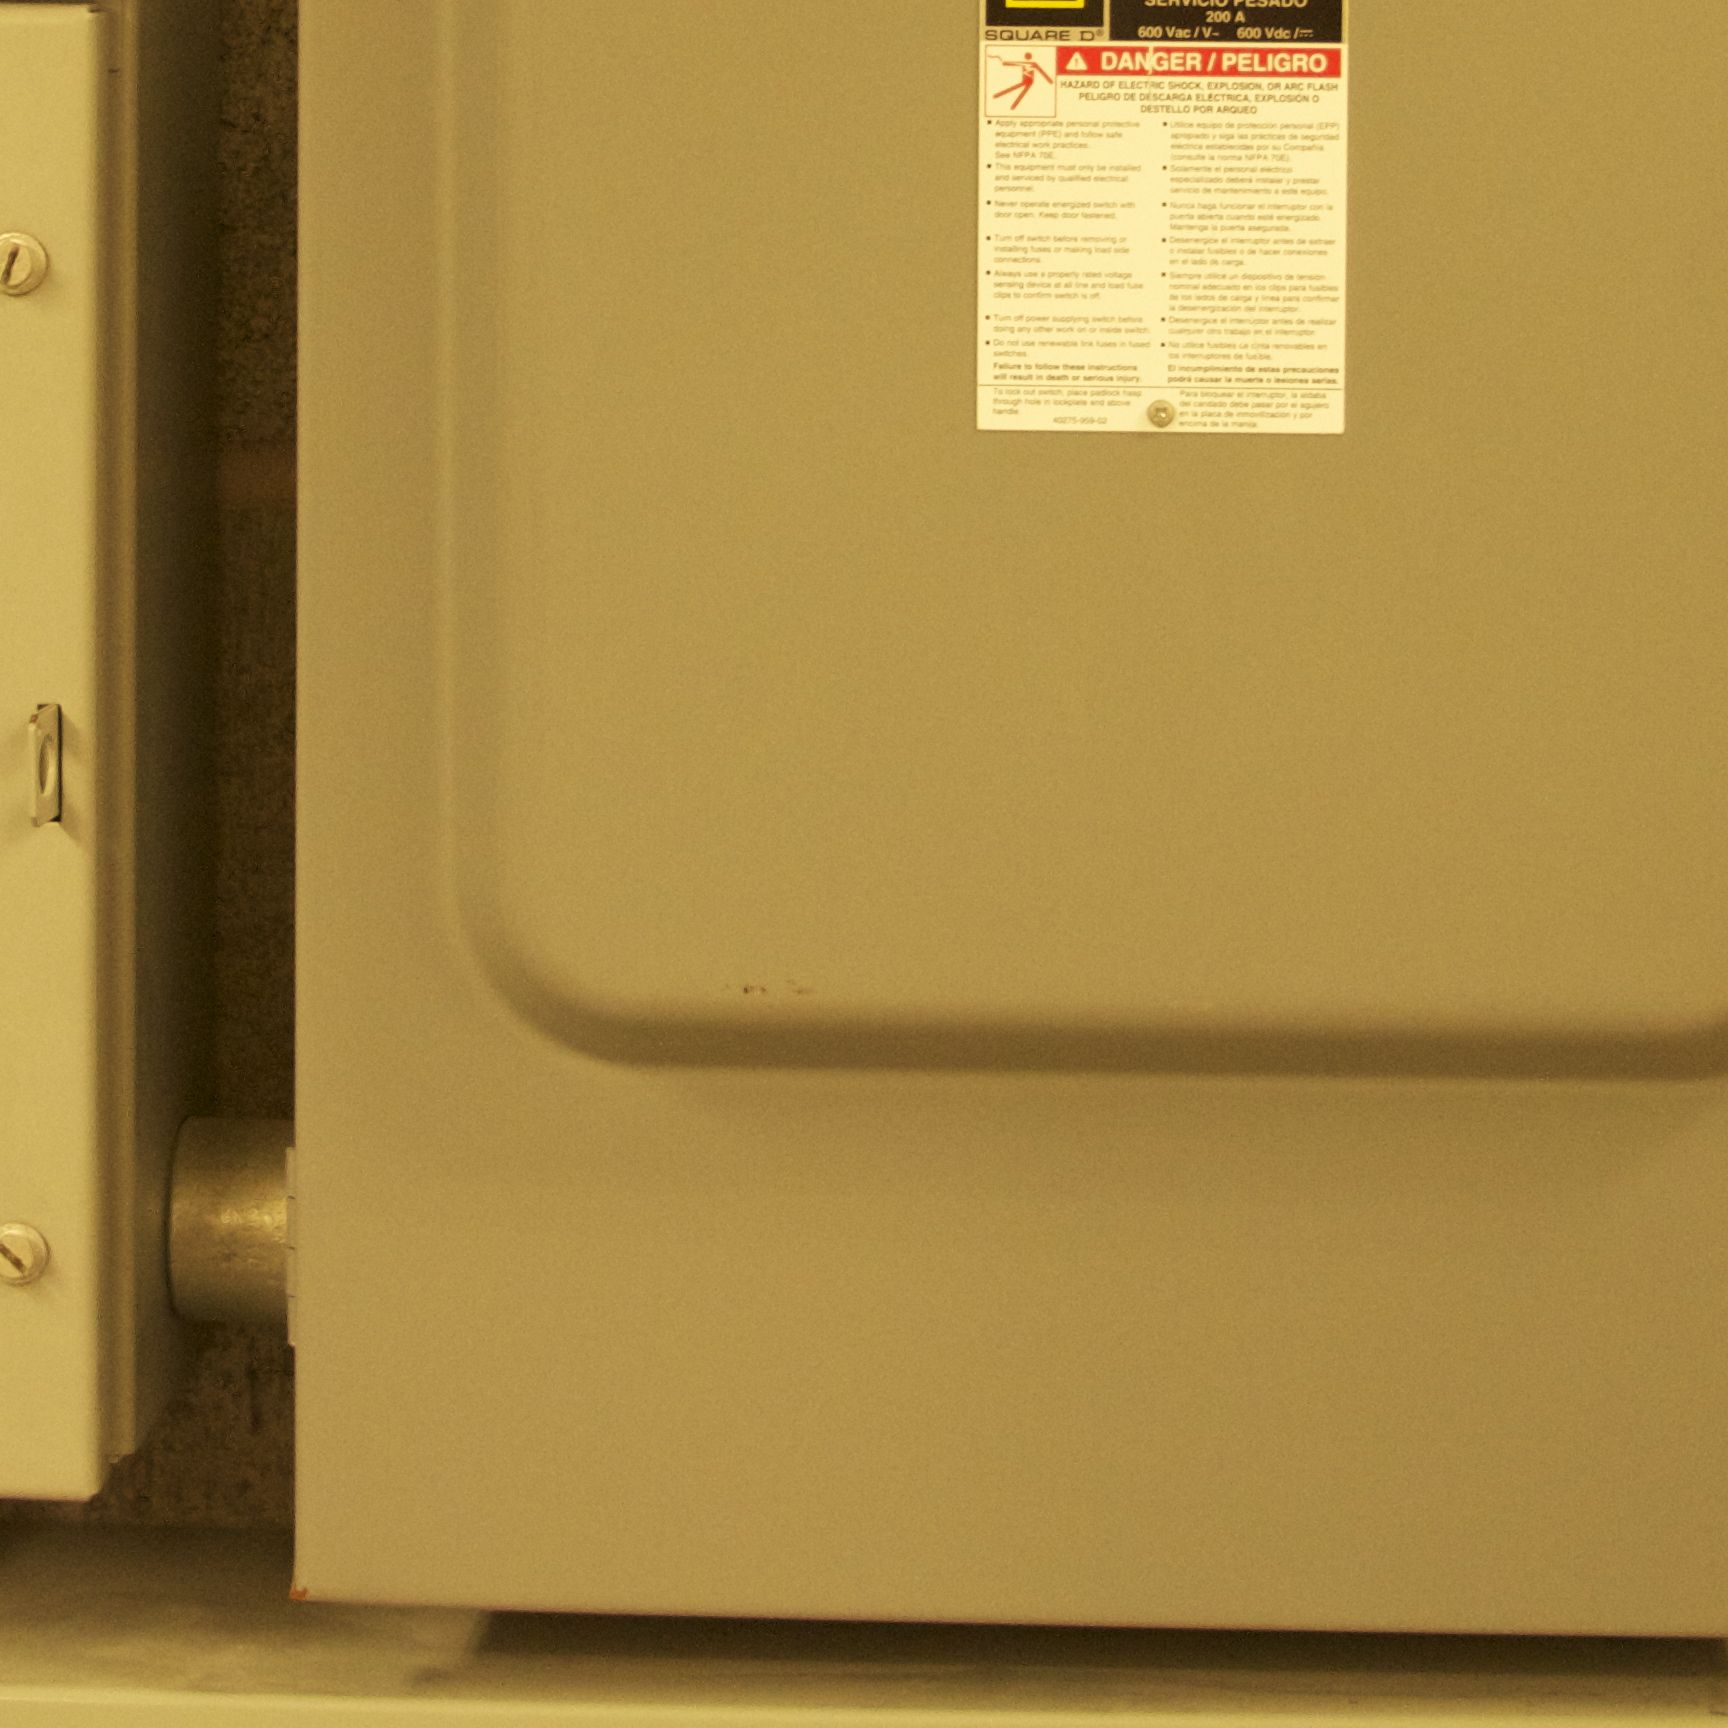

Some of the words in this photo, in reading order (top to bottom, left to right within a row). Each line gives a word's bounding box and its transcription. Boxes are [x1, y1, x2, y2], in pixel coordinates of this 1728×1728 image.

[1206, 10, 1231, 23] 200
[1234, 10, 1246, 23] A
[984, 29, 1071, 42] SQUARE
[1138, 26, 1163, 38] 600
[1165, 26, 1191, 38] Vac
[1236, 27, 1262, 39] 600
[1264, 27, 1291, 39] Vdc
[1101, 53, 1204, 71] DANGER
[1222, 54, 1327, 73] PELIGRO
[1060, 80, 1100, 89] HAZARD
[1102, 80, 1115, 89] OF
[1118, 80, 1165, 90] ELECTRIC
[1168, 81, 1203, 90] SHOCK,
[1207, 81, 1264, 91] EXPLOSION,
[1267, 82, 1281, 91] OR
[1284, 82, 1304, 91] ARC
[1307, 82, 1338, 92] FLASH
[1079, 92, 1121, 101] PELIGRO
[1123, 92, 1136, 101] DE
[1139, 92, 1192, 102] DESCARGA
[1311, 94, 1320, 103] O
[1140, 104, 1191, 114] DESTELLO
[1193, 105, 1214, 114] POR
[1216, 105, 1257, 114] ARQUEO
